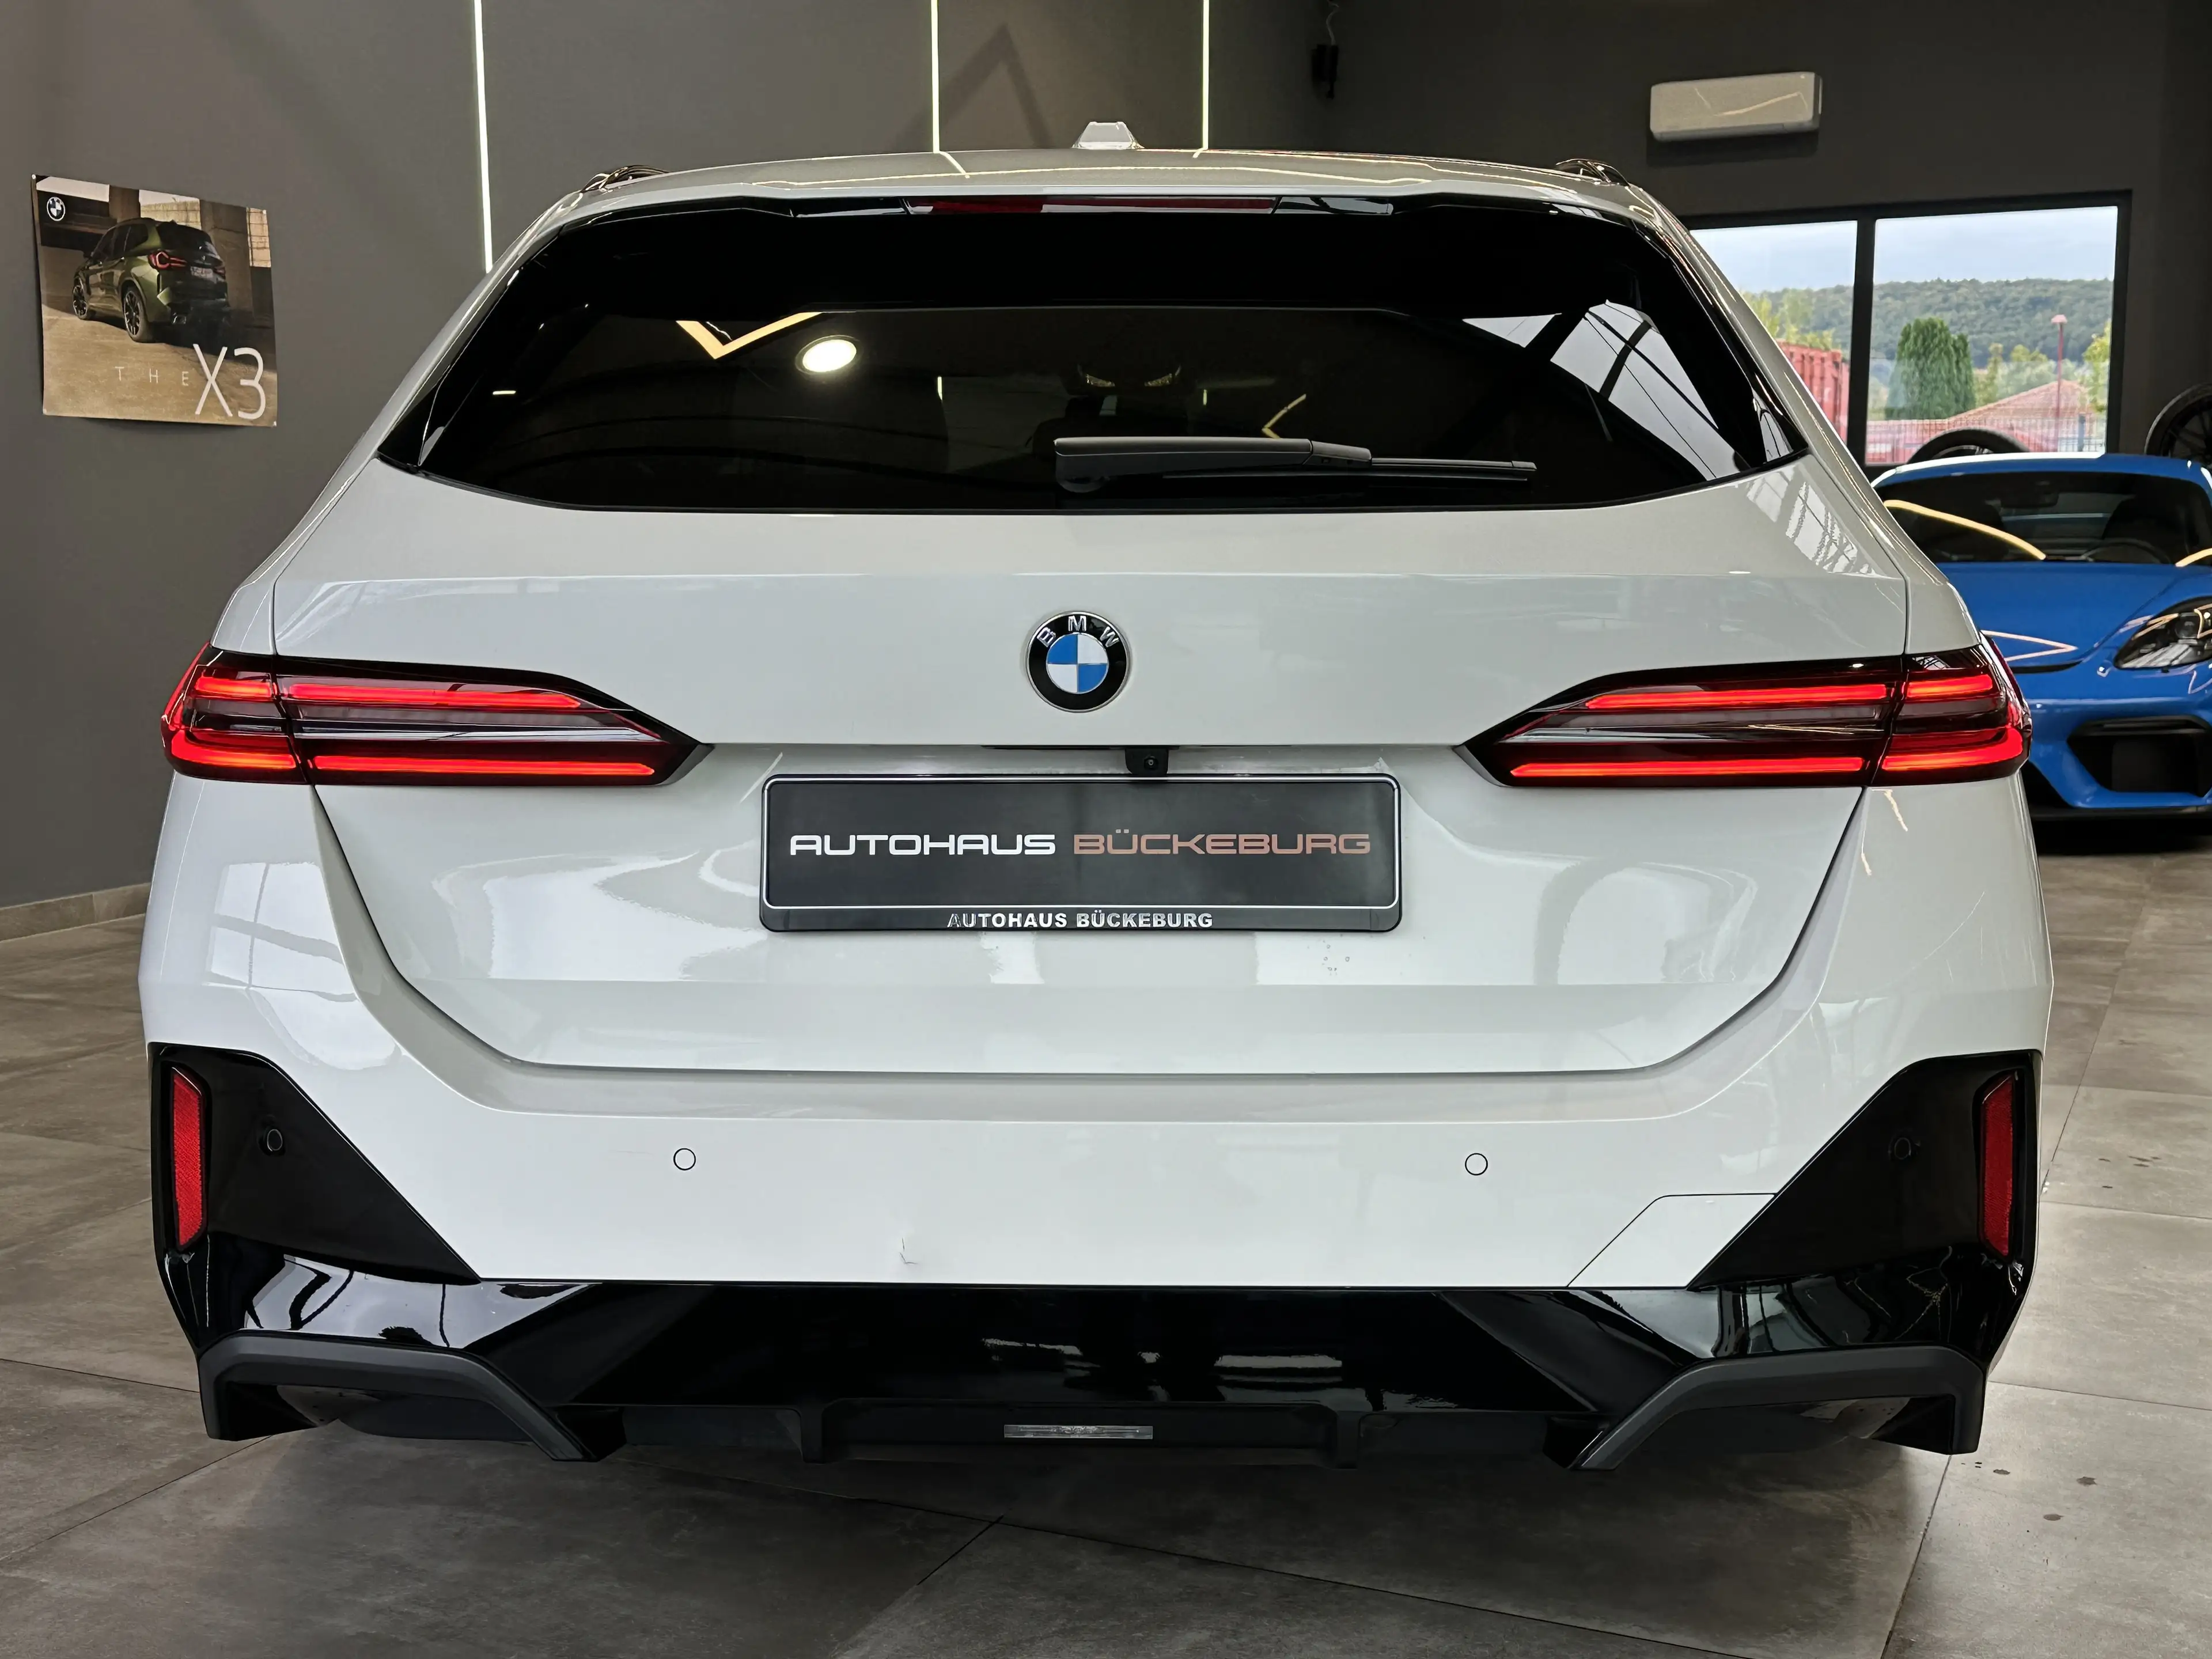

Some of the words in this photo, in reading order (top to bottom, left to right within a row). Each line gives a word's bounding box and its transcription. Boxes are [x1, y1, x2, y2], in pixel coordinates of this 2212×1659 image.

[115, 366, 189, 387] THE
[193, 343, 267, 420] X3
[1037, 615, 1119, 648] BMW
[790, 834, 1056, 855] AUTOHAUS
[1073, 828, 1371, 855] BÜCKEBURG
[946, 912, 1067, 928] AUTOHAUS
[1076, 909, 1213, 929] BÜCKEBURG
